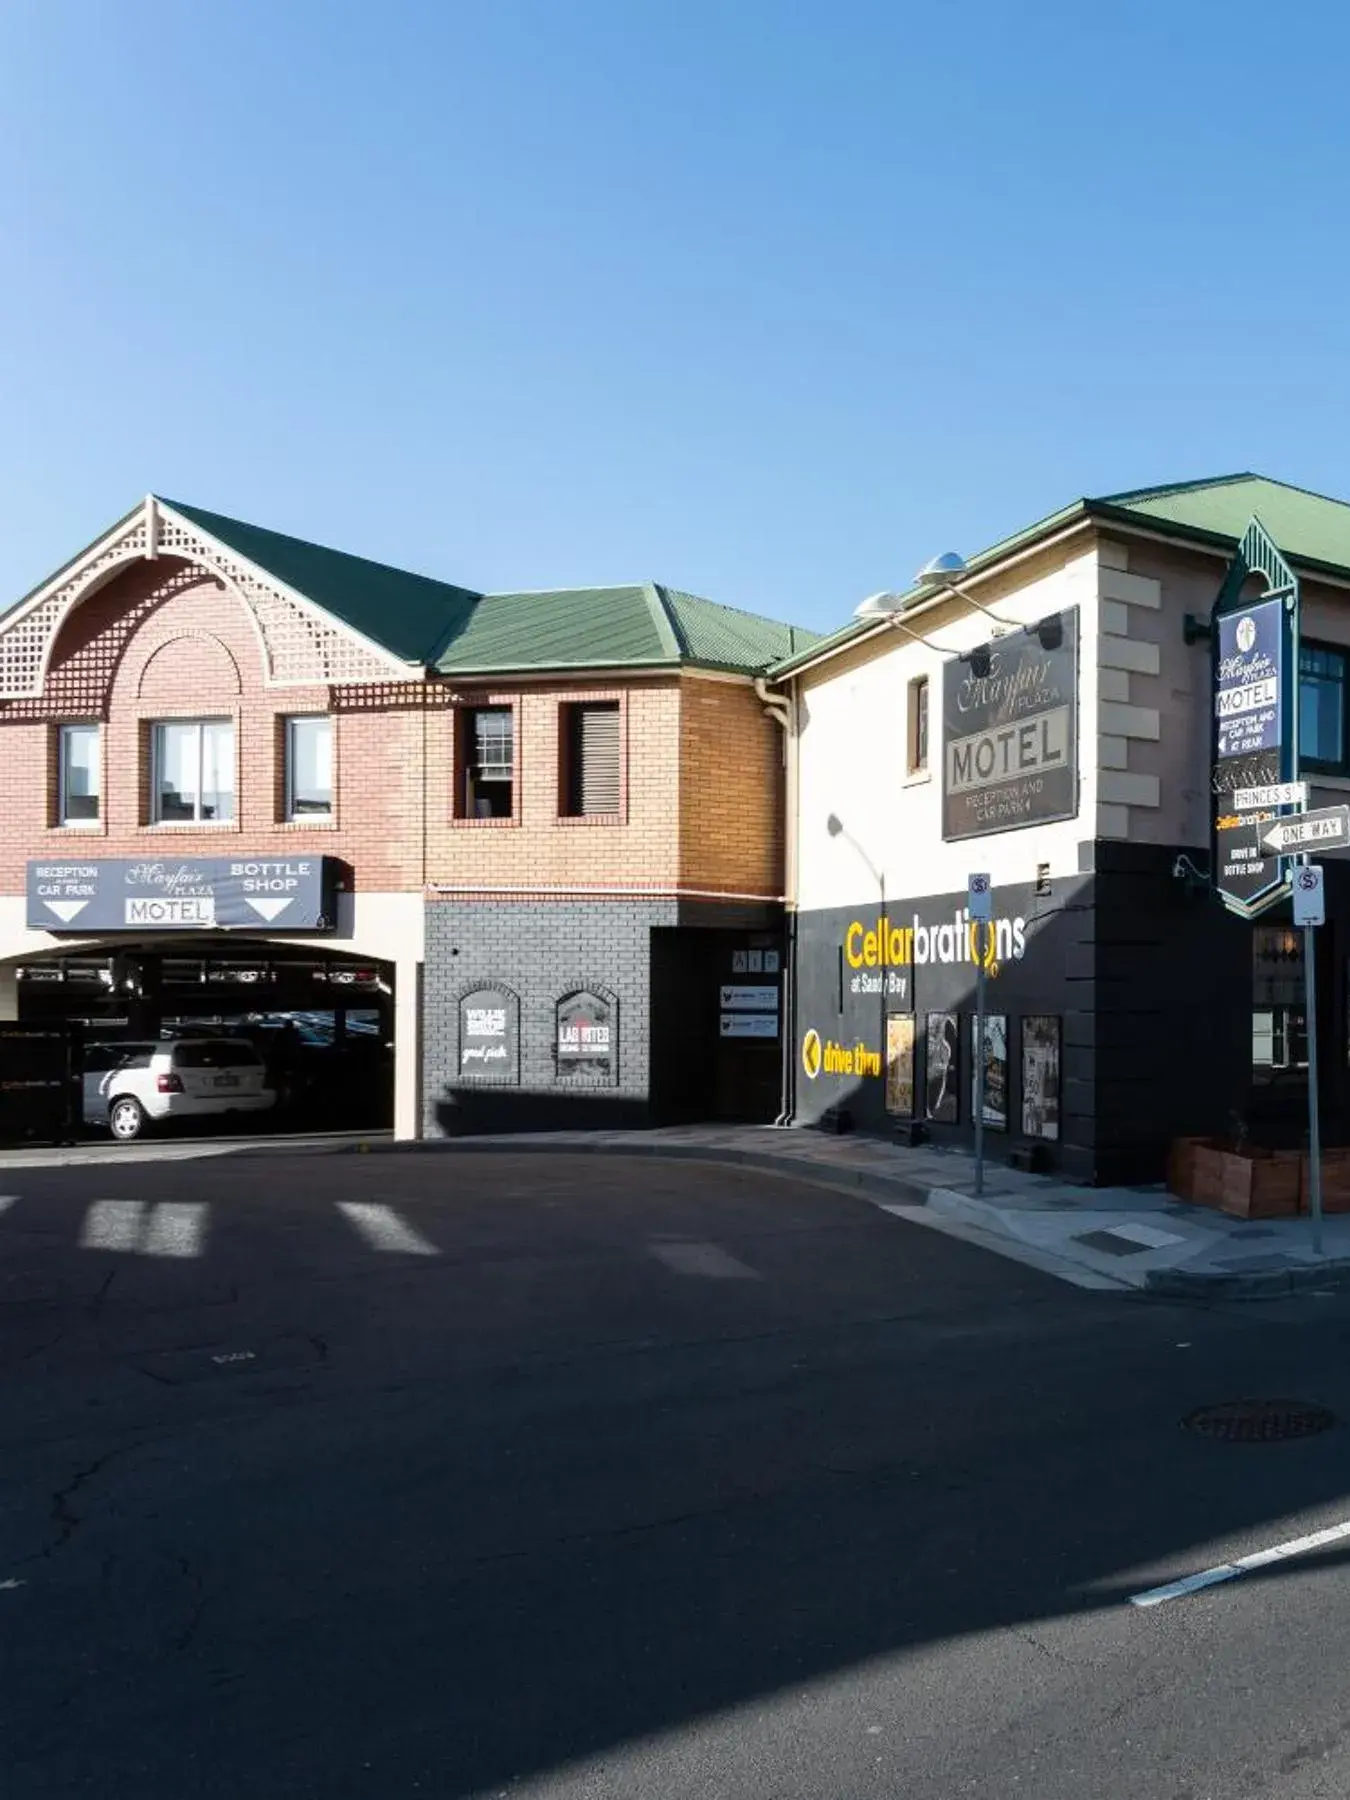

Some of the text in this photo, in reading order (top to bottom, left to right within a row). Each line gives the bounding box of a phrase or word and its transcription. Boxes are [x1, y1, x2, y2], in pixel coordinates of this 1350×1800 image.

[1219, 684, 1273, 712] MOTEL
[952, 719, 1061, 787] MOTEL
[1021, 779, 1043, 796] AND
[1235, 787, 1281, 807] PRINCES
[1282, 820, 1337, 843] ONE WAY
[35, 866, 98, 878] RECEPTION
[230, 862, 311, 876] BOTTLE
[36, 884, 96, 896] CAR PARK
[242, 879, 299, 892] SHOP
[130, 901, 209, 921] MOTEL
[846, 907, 1025, 969] Cellarbrations
[823, 1040, 881, 1077] drive thru
